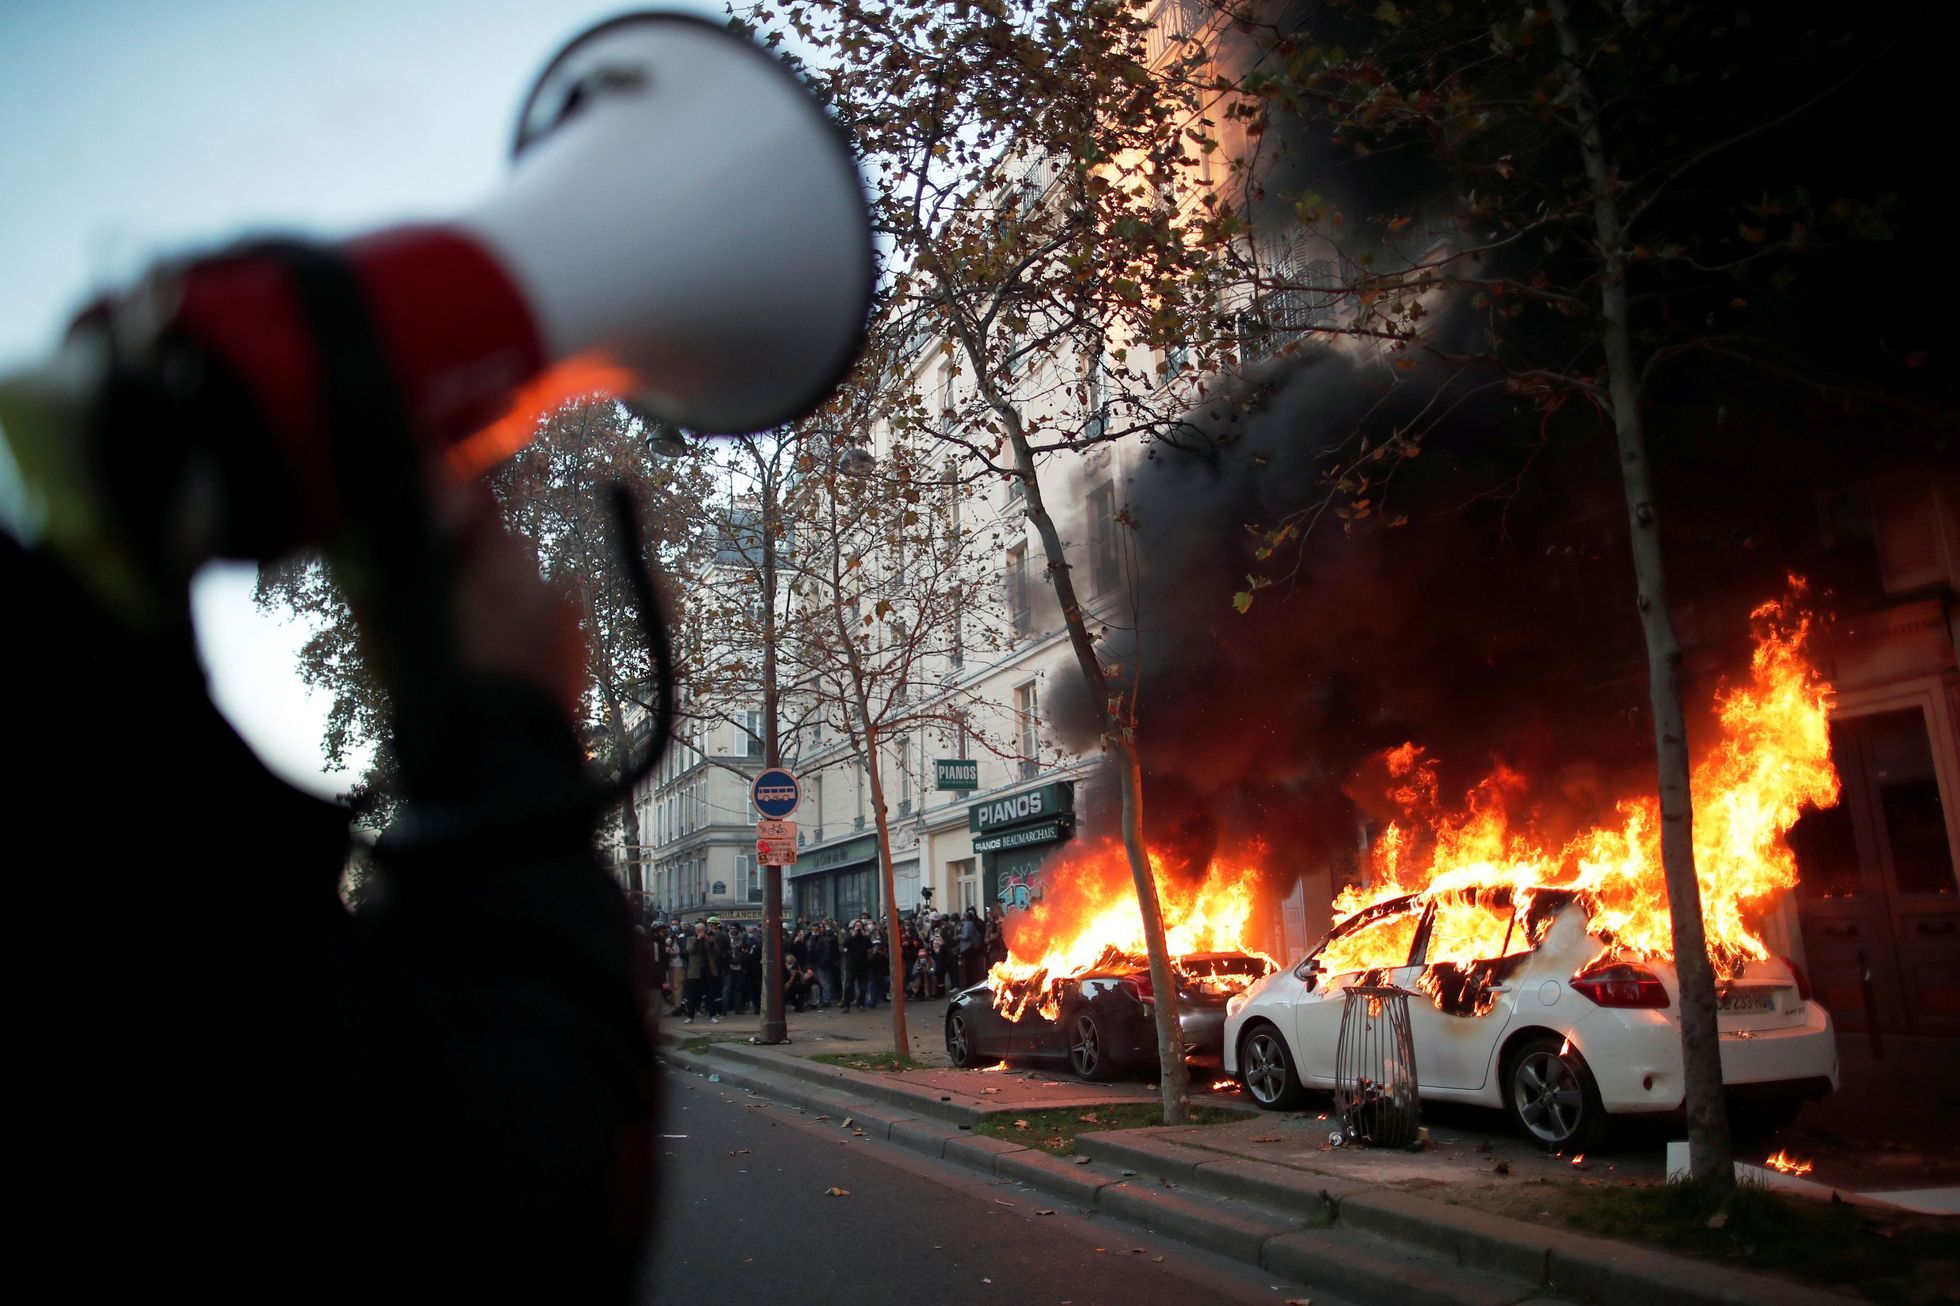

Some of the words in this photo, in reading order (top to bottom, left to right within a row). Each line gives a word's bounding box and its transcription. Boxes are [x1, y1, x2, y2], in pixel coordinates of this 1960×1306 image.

[939, 766, 976, 780] PIANOS
[978, 792, 1041, 827] PIANOS
[975, 839, 1000, 851] PIANOS
[1002, 827, 1055, 847] BEAUMARCHAIS
